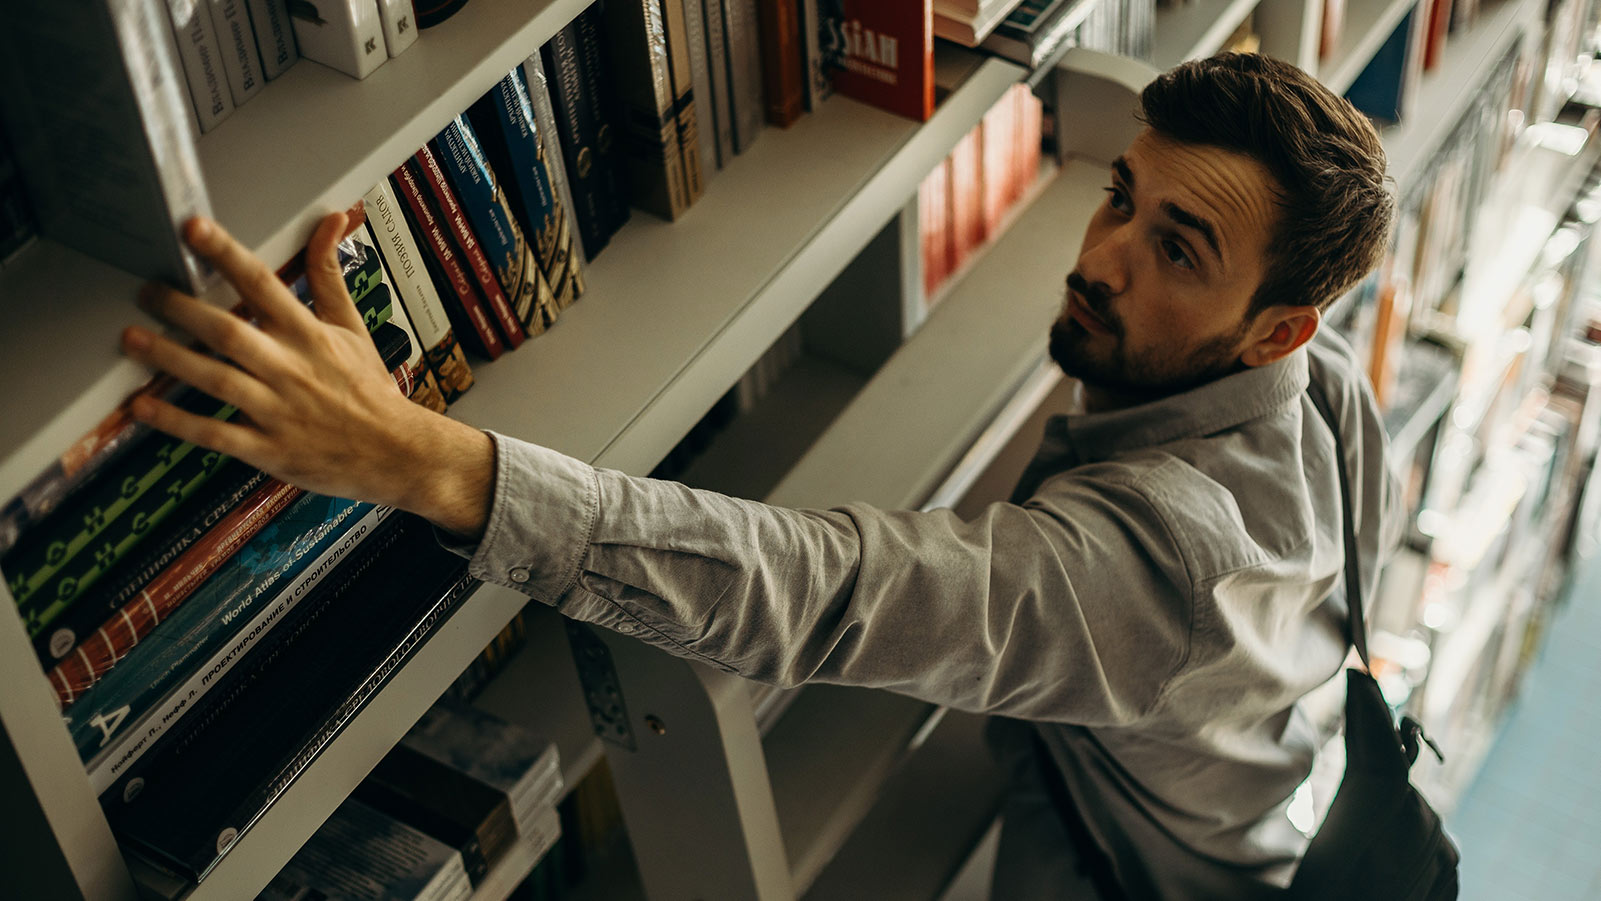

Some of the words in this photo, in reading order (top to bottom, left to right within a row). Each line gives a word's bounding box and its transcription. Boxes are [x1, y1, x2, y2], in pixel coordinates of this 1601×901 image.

[443, 128, 467, 174] АРХИТЕКТУРА
[375, 193, 397, 233] САДОВ
[391, 231, 415, 278] ПОЭЗИЯ
[106, 525, 203, 609] СПЕЦИФИКА
[201, 468, 269, 528] СРЕДОВО
[240, 511, 272, 541] ГОРОДОВ
[220, 594, 253, 625] World
[251, 570, 282, 598] Atlas
[280, 558, 294, 572] of
[292, 505, 355, 561] Sustainable
[109, 736, 149, 773] Нойферт
[161, 698, 188, 723] Нефф
[200, 603, 286, 685] ПРОЕКТИРОВАНИЕ
[285, 595, 294, 605] И
[292, 525, 368, 597] СТРОИТЕЛЬСТВО
[262, 717, 343, 804] СПЕЦИФИКА
